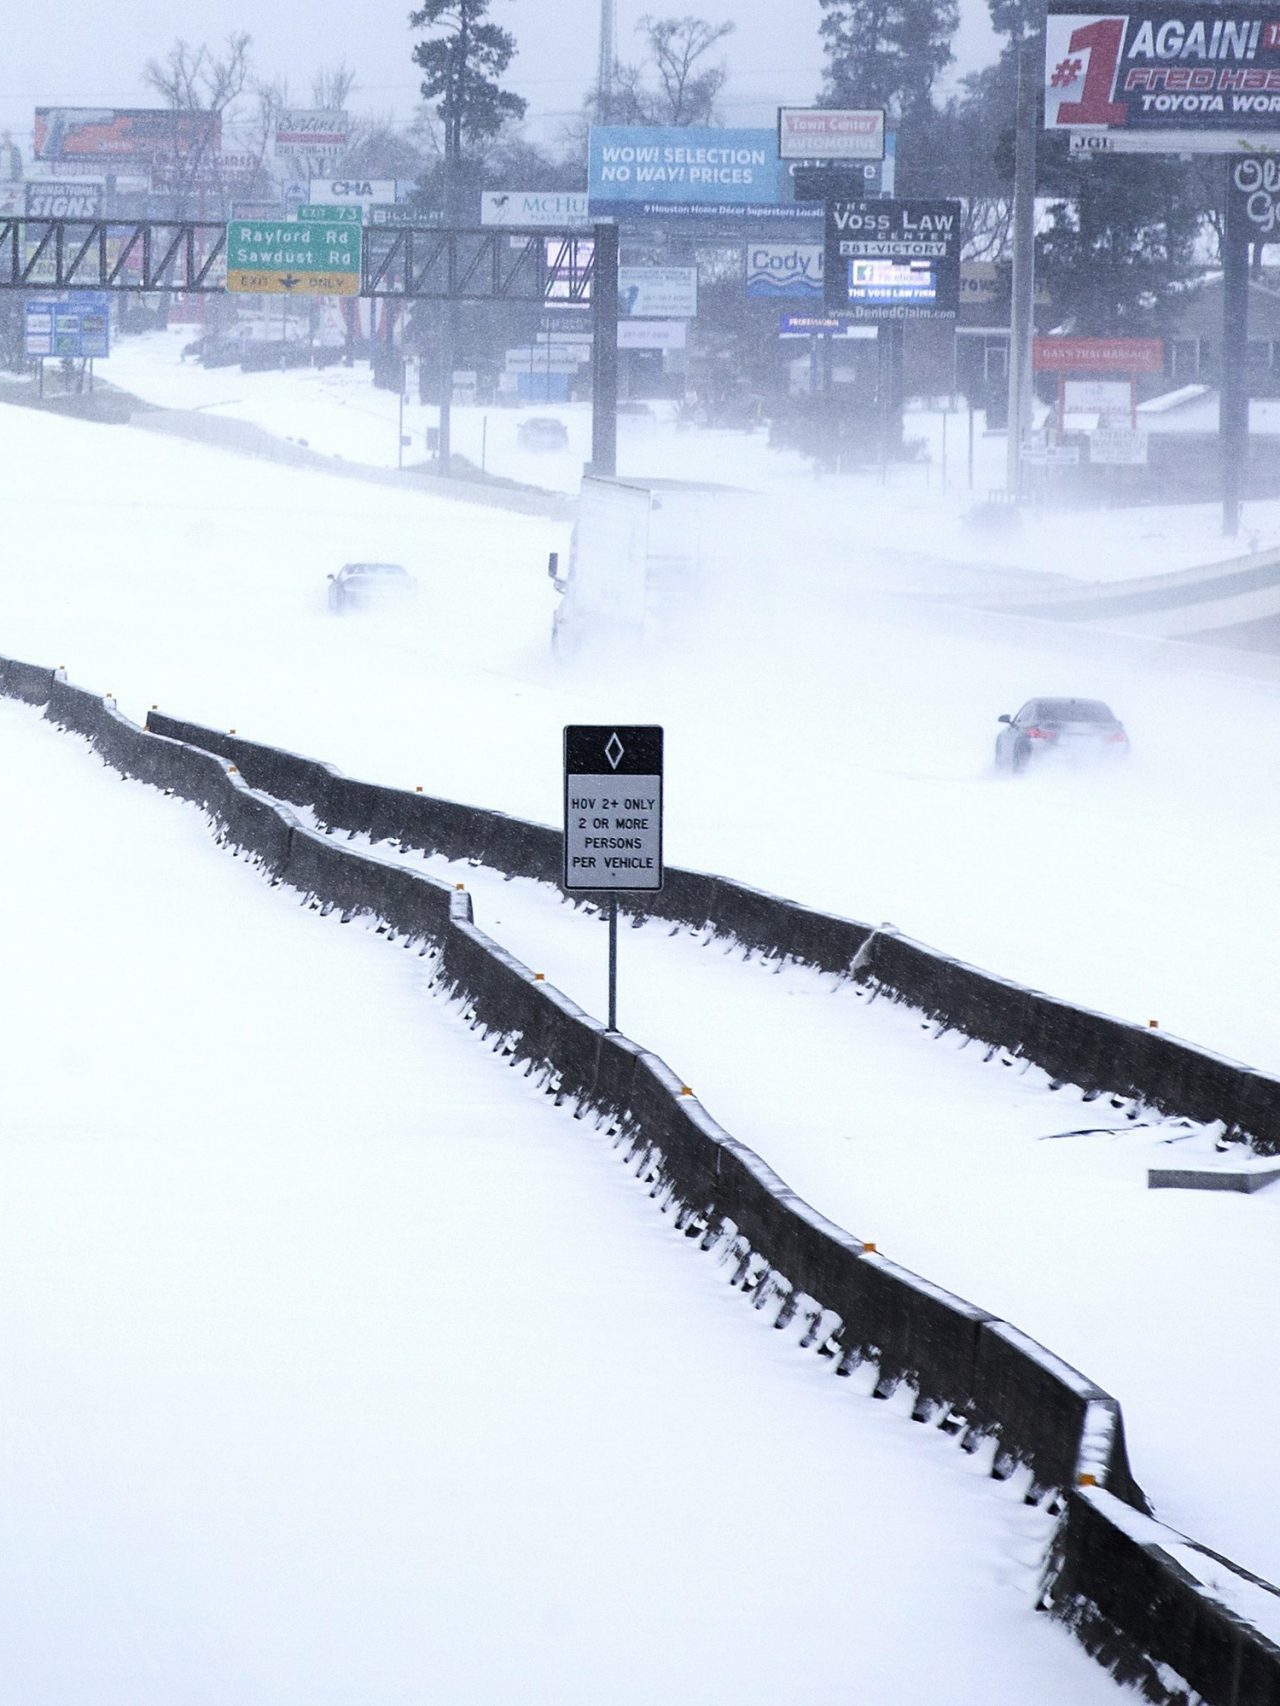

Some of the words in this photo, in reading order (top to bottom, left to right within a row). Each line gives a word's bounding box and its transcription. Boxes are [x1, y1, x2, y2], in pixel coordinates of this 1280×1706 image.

[1128, 20, 1261, 59] AGAIN!
[1142, 94, 1225, 111] TOYOTA
[794, 117, 825, 130] Town
[830, 117, 871, 130] Center
[602, 147, 659, 163] WOW!
[664, 148, 765, 165] SELECTION
[601, 167, 630, 182] NO
[637, 167, 685, 182] WAY!
[689, 168, 753, 184] PRICES
[28, 196, 98, 217] SIGNS
[337, 206, 358, 220] 73
[651, 205, 689, 214] Houston
[691, 205, 717, 214] Home
[747, 206, 795, 217] Superstore
[835, 202, 868, 211] THE
[833, 211, 890, 230] VOSS
[903, 210, 954, 231] LAW
[240, 227, 310, 246] Rayford
[325, 229, 349, 244] Rd
[877, 232, 953, 241] CENTER
[841, 243, 944, 255] 281-VICTORY
[237, 249, 313, 264] Sawdust
[329, 250, 351, 265] Rd
[752, 251, 812, 274] Cody
[240, 276, 269, 287] EXIT
[309, 277, 346, 288] ONLY
[848, 289, 866, 298] THE
[868, 289, 891, 298] VOSS
[893, 289, 912, 298] LAW
[828, 305, 956, 319] www.DeniedClaim.com
[571, 798, 597, 810] HOV
[602, 798, 619, 810] 2+
[624, 798, 656, 810] ONLY
[578, 818, 586, 829] 2
[593, 818, 610, 829] OR
[616, 818, 649, 829] MORE
[584, 837, 642, 849] PERSONS
[572, 856, 596, 868] PER
[604, 857, 654, 869] VEHICLE
